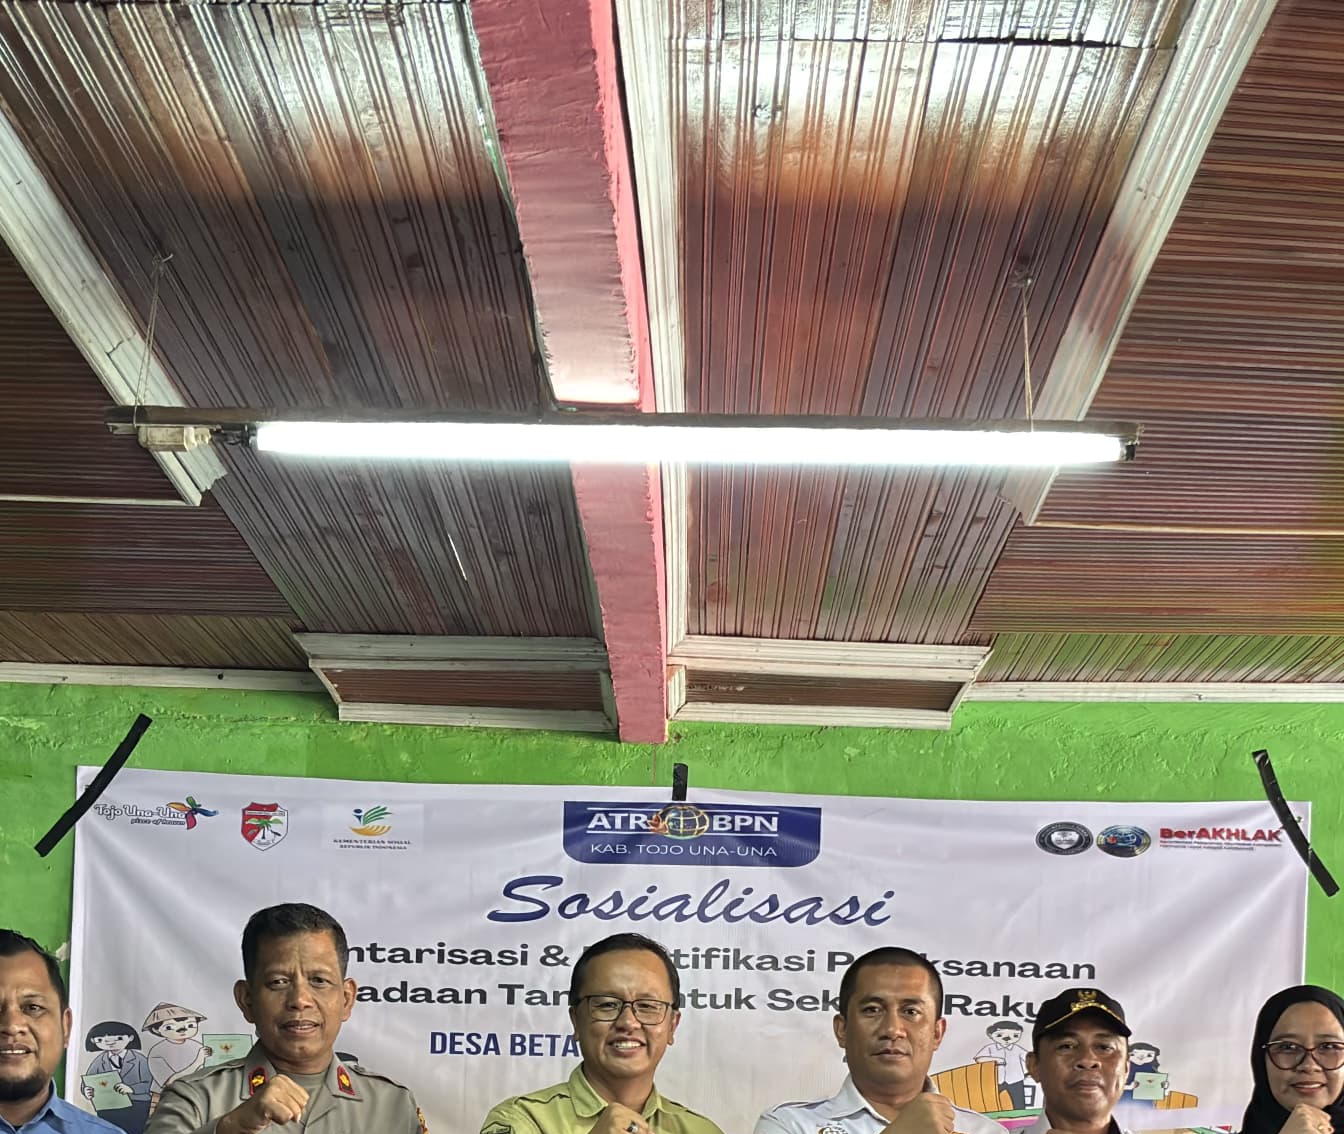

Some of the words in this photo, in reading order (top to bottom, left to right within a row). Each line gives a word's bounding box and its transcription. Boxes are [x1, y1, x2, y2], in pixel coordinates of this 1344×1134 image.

[94, 804, 122, 820] Tojo
[587, 813, 651, 831] ATR
[712, 815, 778, 832] BPN
[1159, 827, 1282, 841] BerAKHLAK
[591, 844, 631, 854] KAB.
[636, 845, 683, 855] TOJO
[689, 845, 778, 857] UNA-UNA
[487, 875, 895, 926] Sosialisasi
[348, 942, 528, 966] ntarisasi
[539, 945, 571, 967] &
[669, 947, 816, 972] tifikasi
[356, 980, 487, 1005] adaan
[498, 984, 570, 1007] Tan
[766, 988, 841, 1012] Sek
[943, 994, 1040, 1024] Raky
[430, 1031, 501, 1057] DESA
[509, 1033, 580, 1058] BETA
